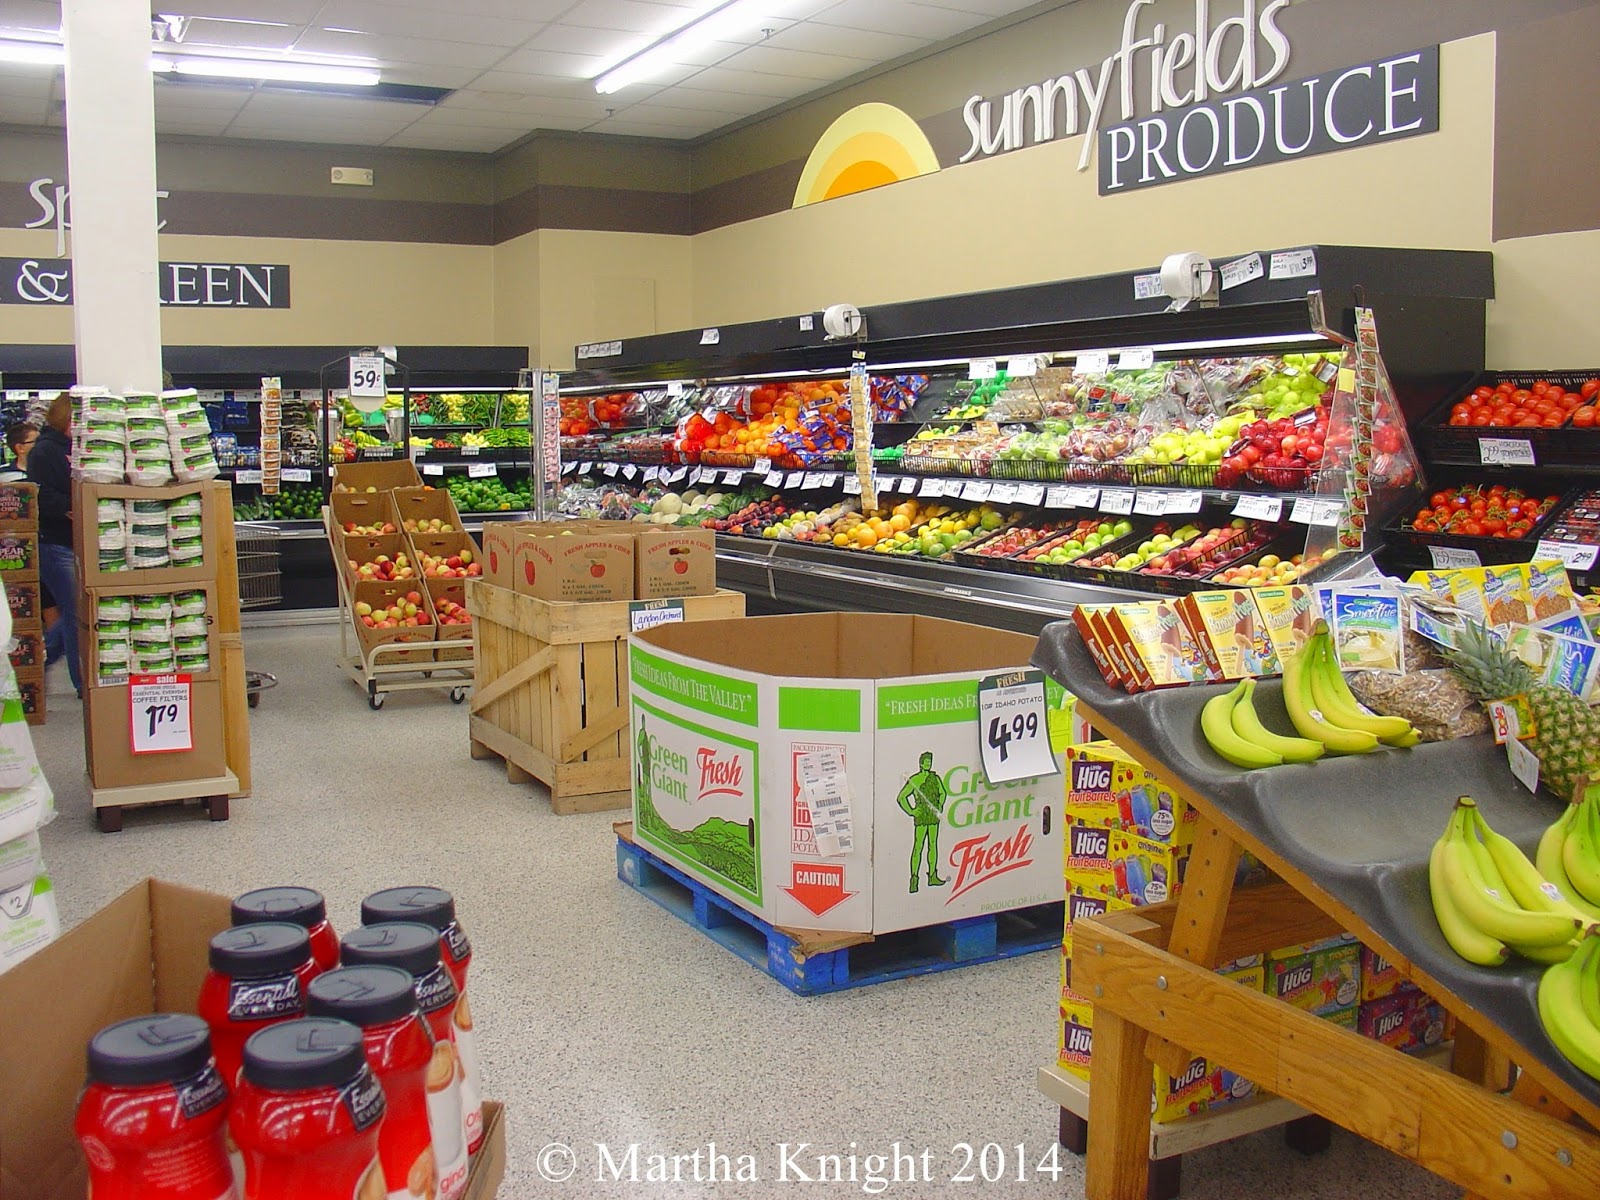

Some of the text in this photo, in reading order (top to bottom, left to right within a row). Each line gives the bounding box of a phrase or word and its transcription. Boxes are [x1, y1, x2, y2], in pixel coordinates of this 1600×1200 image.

[959, 0, 1291, 172] sunnyfields
[1106, 52, 1424, 190] PRODUCE
[16, 260, 69, 303] &
[564, 544, 584, 557] FRESH
[585, 541, 608, 549] APPLES
[644, 600, 669, 610] FRESH
[1337, 603, 1397, 621] Smoothie
[156, 675, 178, 684] sale!
[649, 666, 668, 688] IDEAS
[668, 672, 689, 696] FROM
[690, 680, 708, 700] THE
[996, 671, 1026, 688] FRESH
[930, 696, 965, 711] IDEAS
[995, 699, 1016, 709] IDAHO
[1017, 696, 1042, 706] POTATO
[650, 734, 688, 776] Green
[696, 747, 744, 792] Fresh
[1077, 766, 1110, 790] HUG
[651, 763, 688, 804] Giant
[946, 794, 1035, 829] Giant
[1075, 832, 1107, 855] HUG
[949, 823, 1035, 894] Fresh
[796, 870, 840, 887] CAUTION
[234, 978, 299, 1005] Essential
[1282, 967, 1312, 993] HUG
[1378, 1011, 1404, 1037] HUG
[1068, 1028, 1093, 1051] HU
